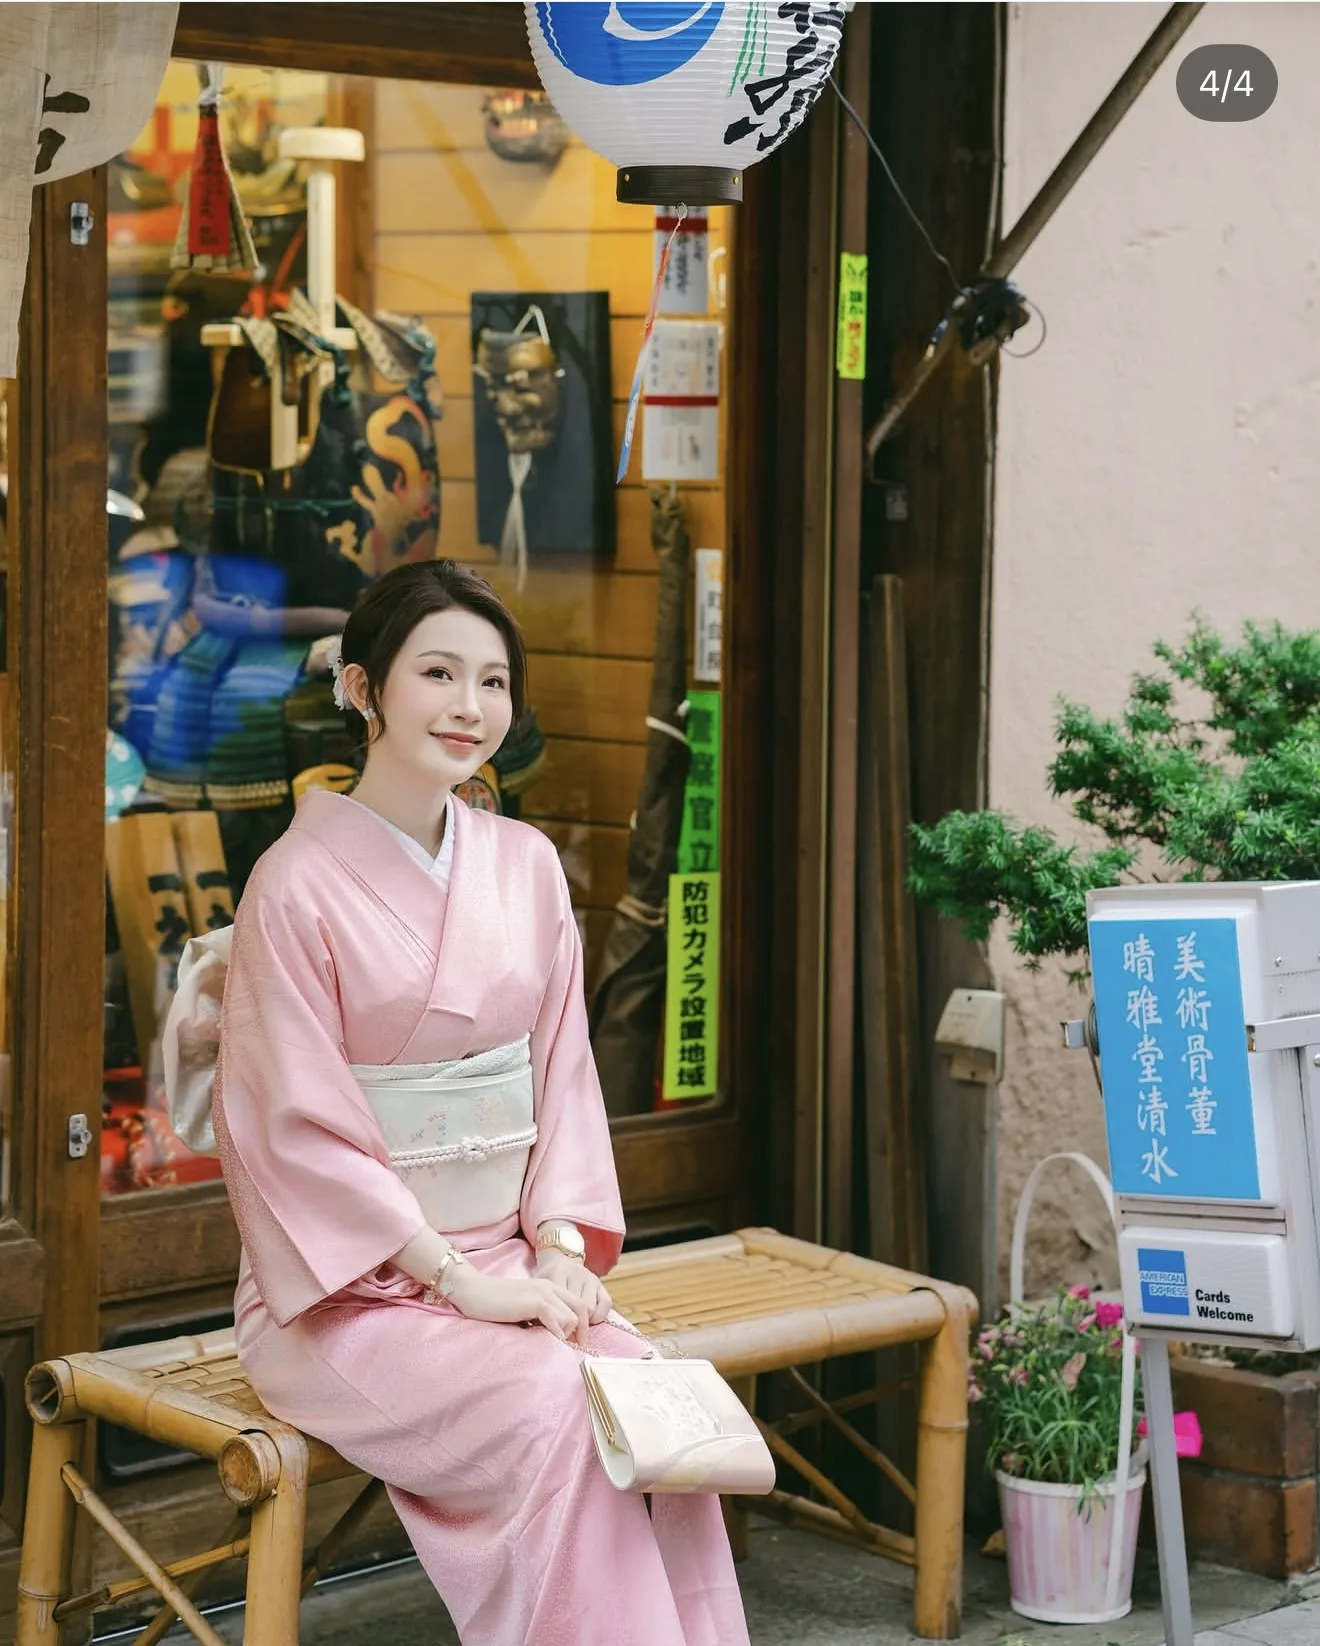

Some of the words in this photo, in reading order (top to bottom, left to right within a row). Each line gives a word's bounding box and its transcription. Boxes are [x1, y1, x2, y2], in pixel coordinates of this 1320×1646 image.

[1123, 932, 1178, 1184] 晴雅堂清水
[1173, 930, 1218, 1135] 美術骨董
[1195, 1289, 1231, 1304] Cards
[1197, 1306, 1254, 1322] Welcome
